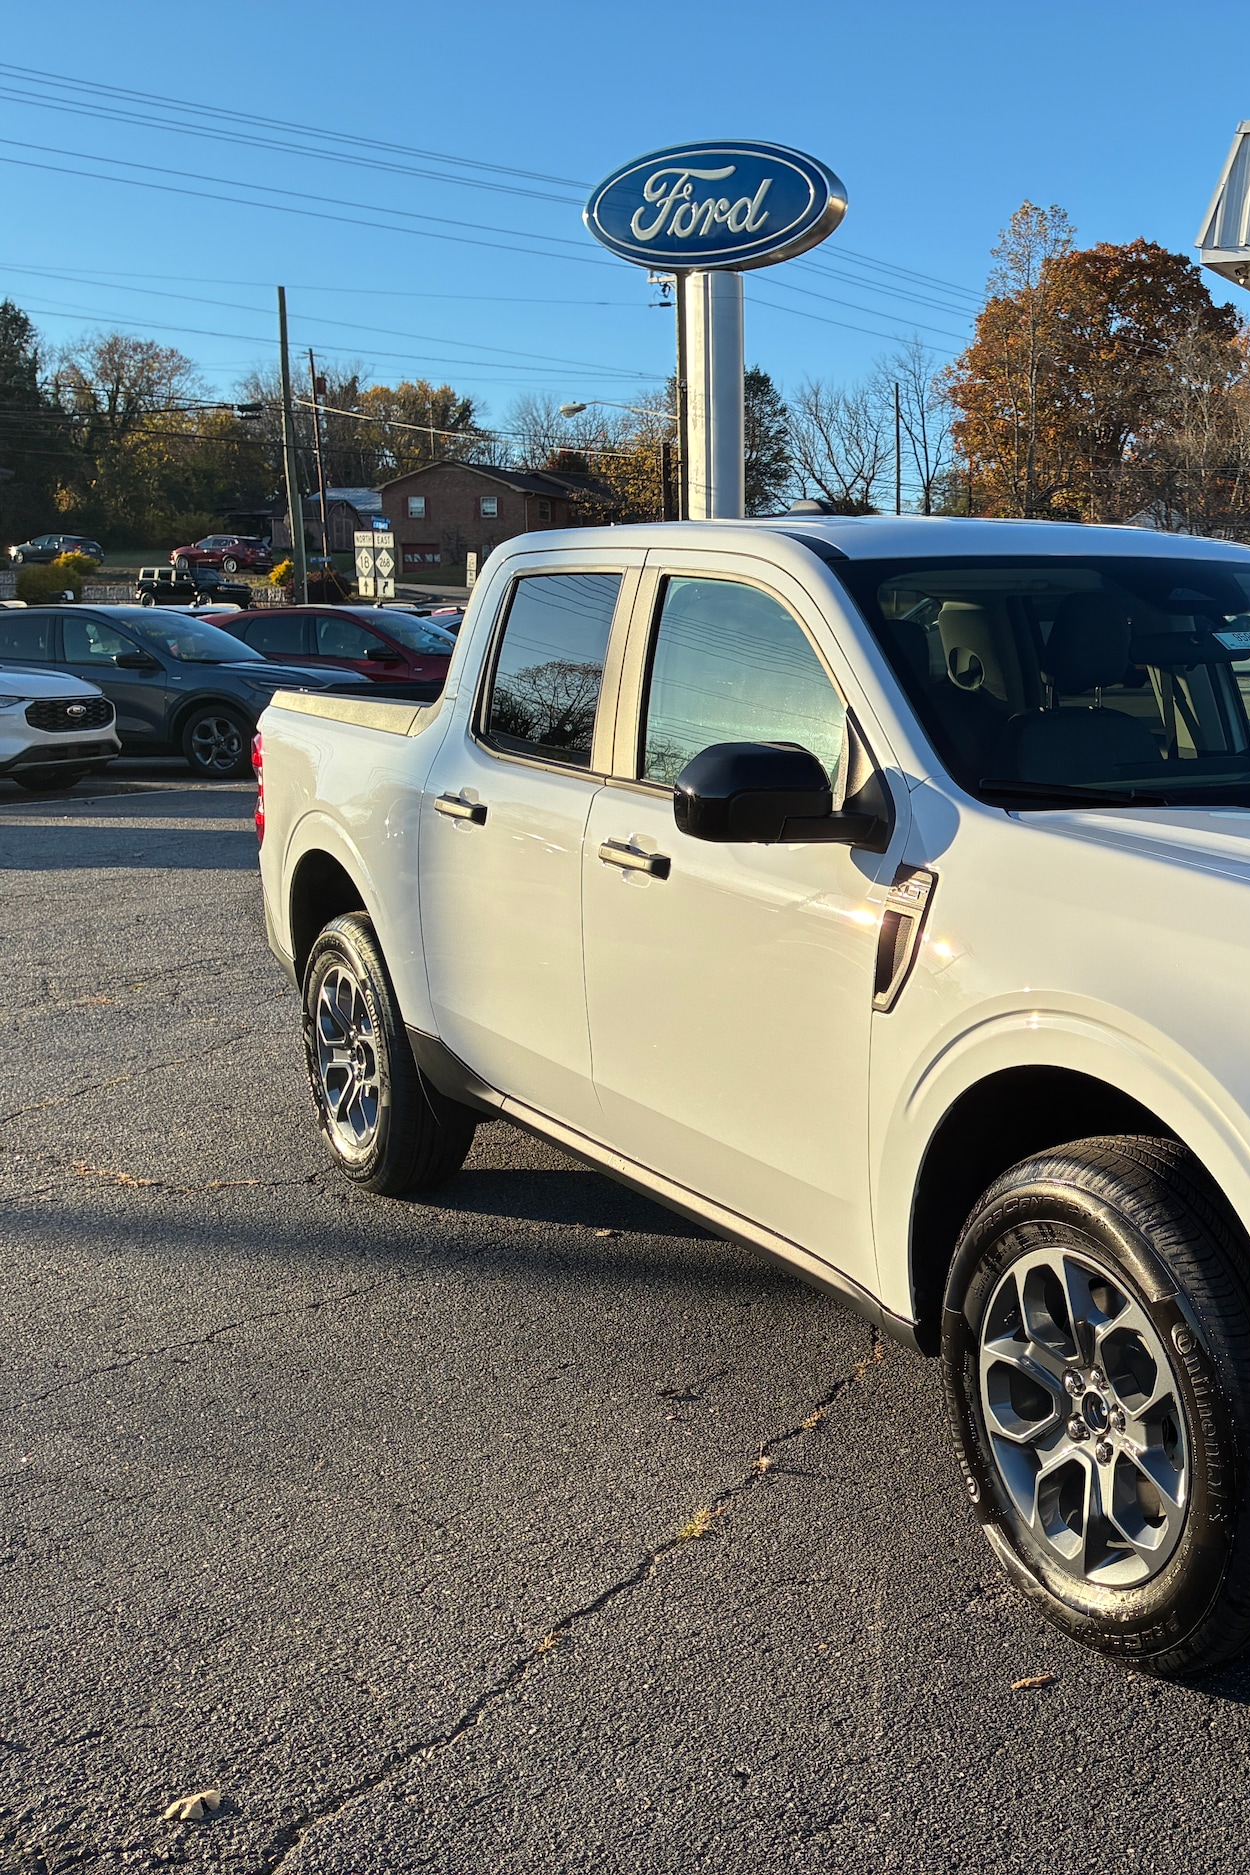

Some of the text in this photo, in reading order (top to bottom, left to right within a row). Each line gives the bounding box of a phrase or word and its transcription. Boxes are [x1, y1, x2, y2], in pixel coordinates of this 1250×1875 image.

[630, 165, 773, 241] Ford
[355, 532, 372, 544] NORTH
[376, 535, 391, 545] EAST
[360, 556, 370, 569] 18
[379, 557, 391, 568] 268
